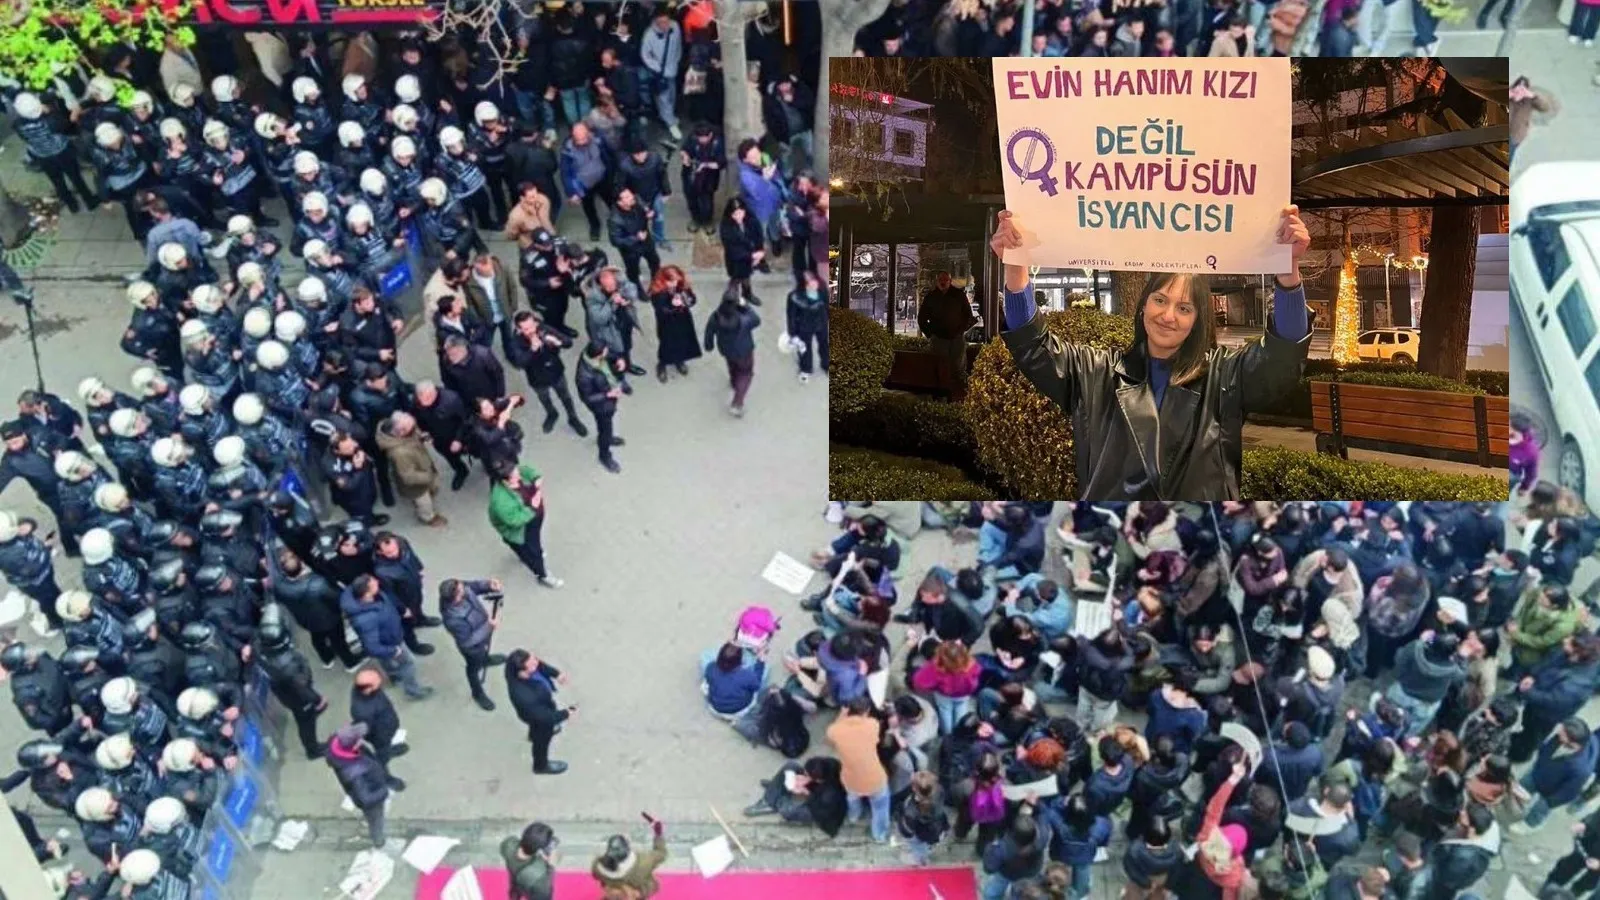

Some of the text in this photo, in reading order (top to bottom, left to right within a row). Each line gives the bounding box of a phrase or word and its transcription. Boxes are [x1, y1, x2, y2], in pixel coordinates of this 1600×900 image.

[1007, 65, 1257, 100] EVİN HANIM KIZI
[1096, 117, 1196, 156] DEĞİL
[1065, 157, 1257, 196] KAMPÜSÜN
[1077, 194, 1234, 233] İSYANCISI
